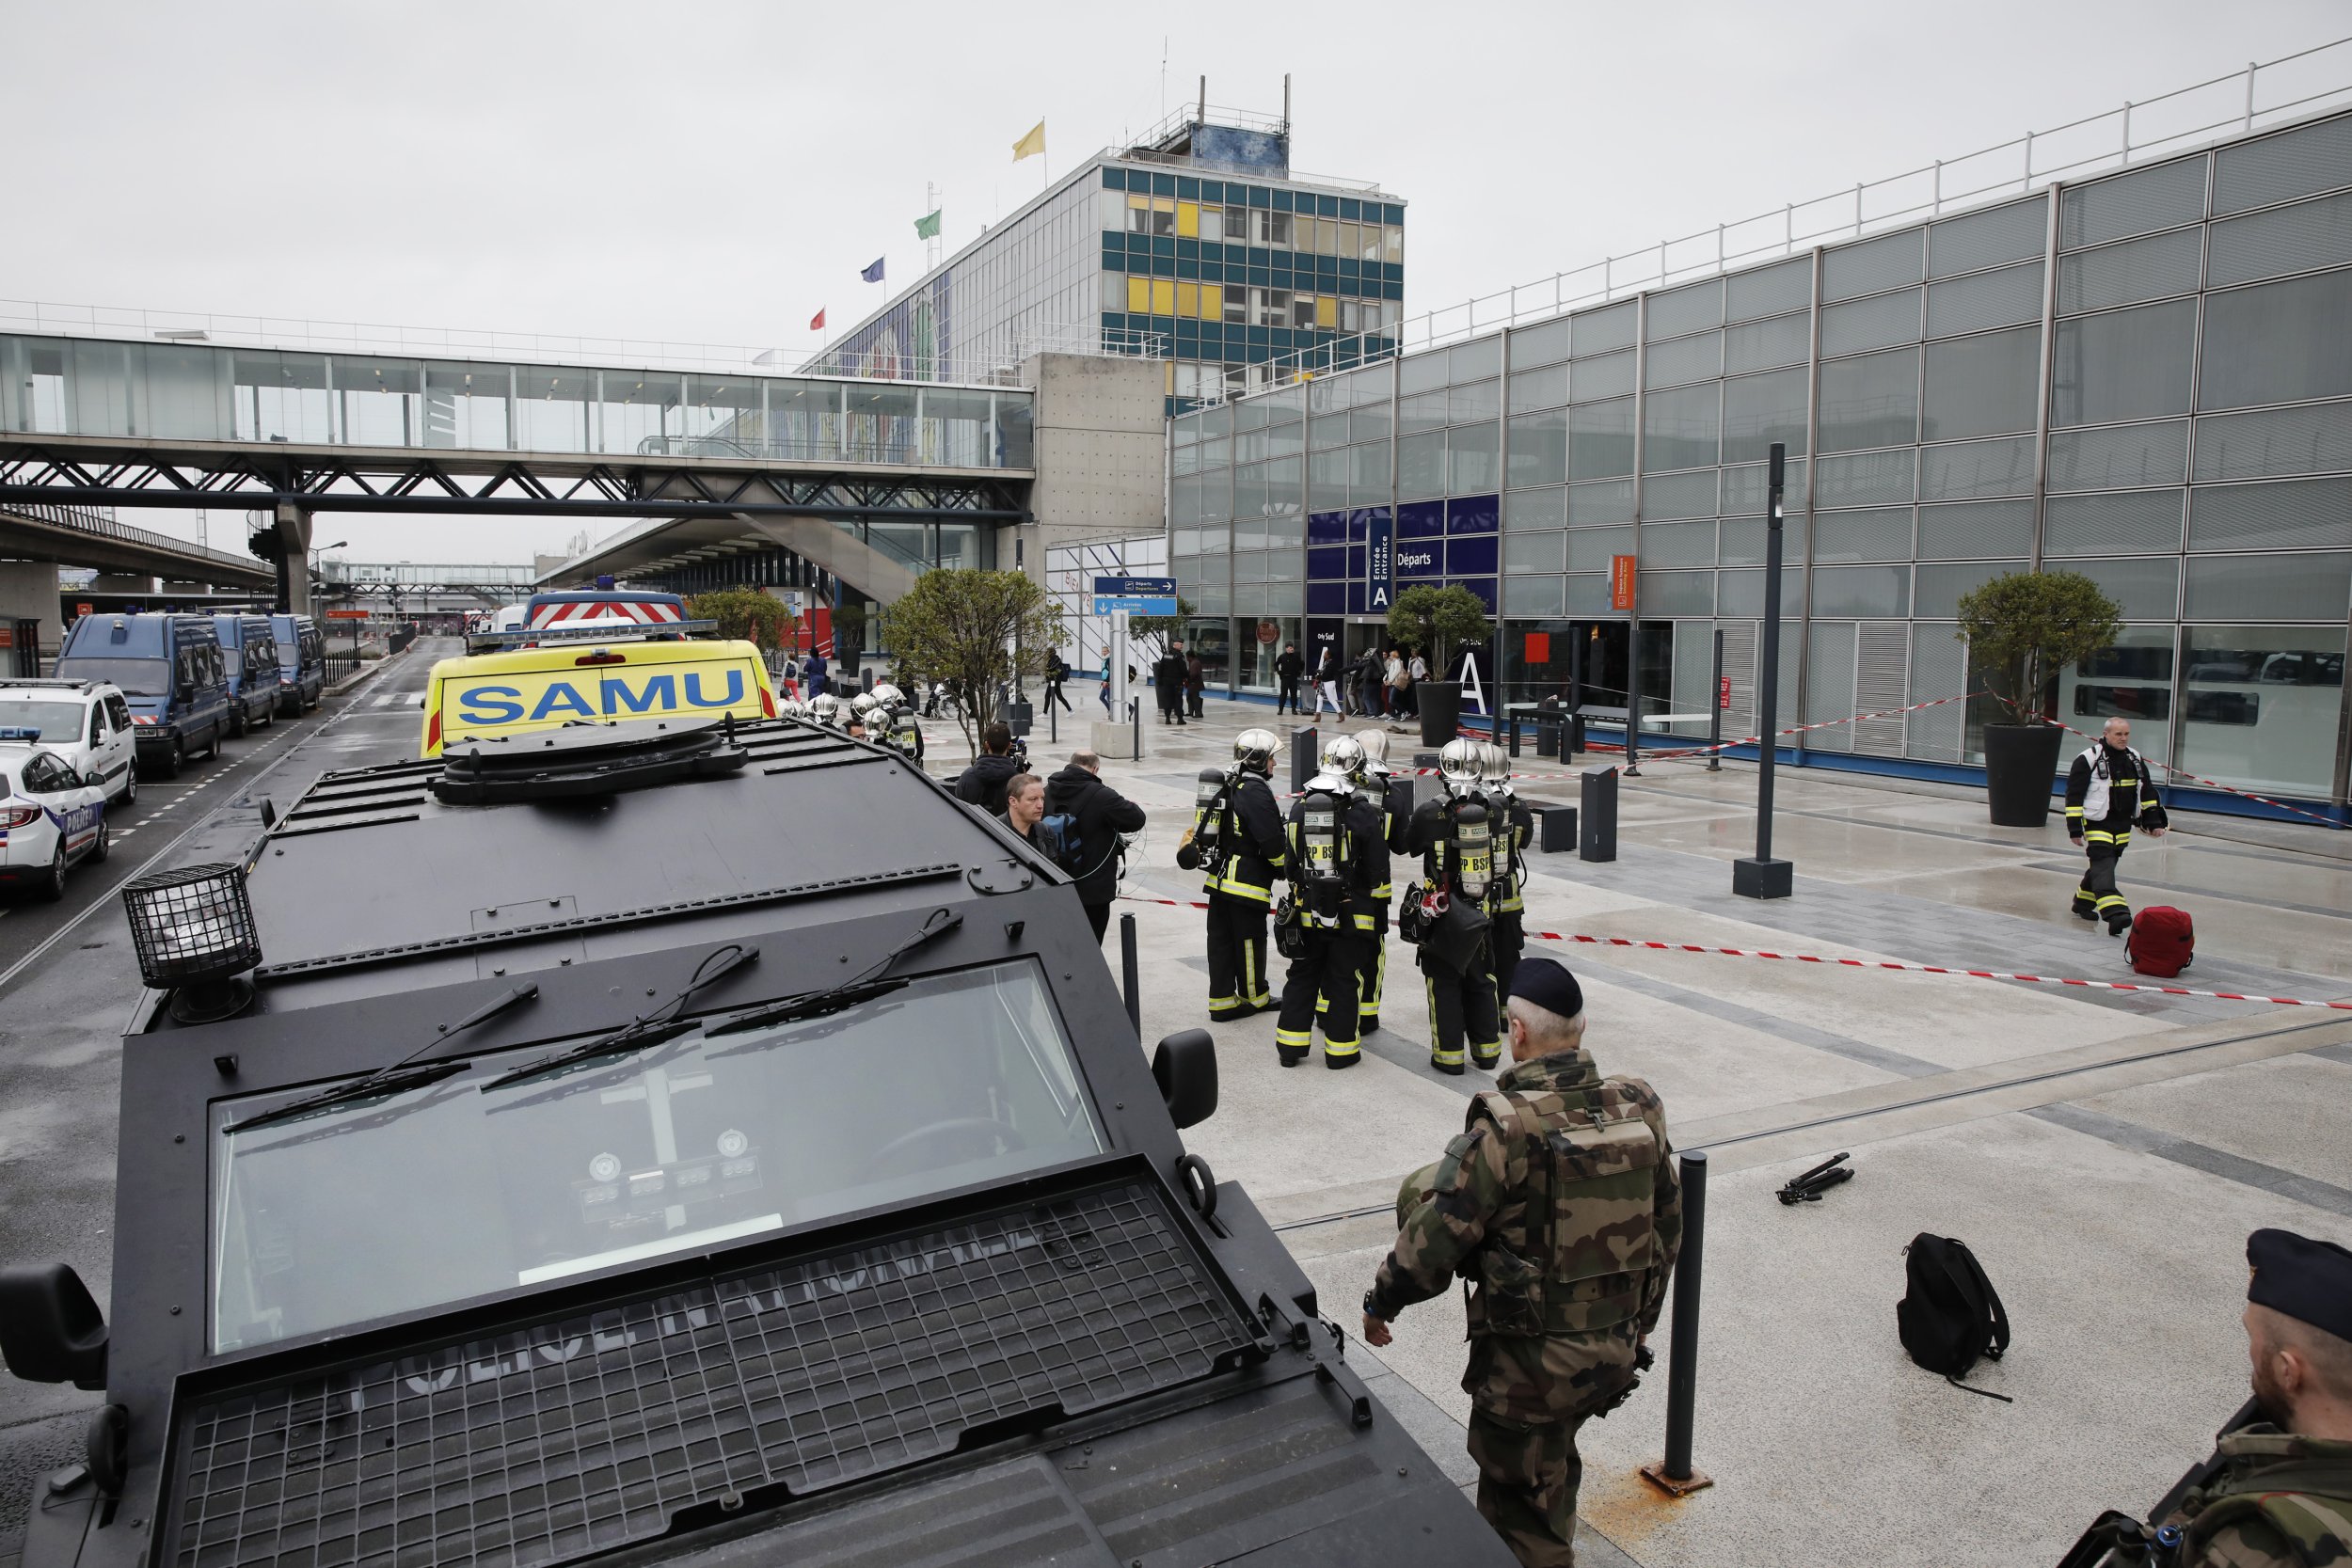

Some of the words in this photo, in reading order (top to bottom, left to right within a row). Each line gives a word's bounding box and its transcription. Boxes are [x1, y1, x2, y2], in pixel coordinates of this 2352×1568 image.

[1397, 552, 1431, 568] Départs
[1374, 587, 1388, 606] A
[1460, 653, 1486, 715] A
[459, 670, 744, 725] SAMU
[67, 809, 89, 833] POLICE
